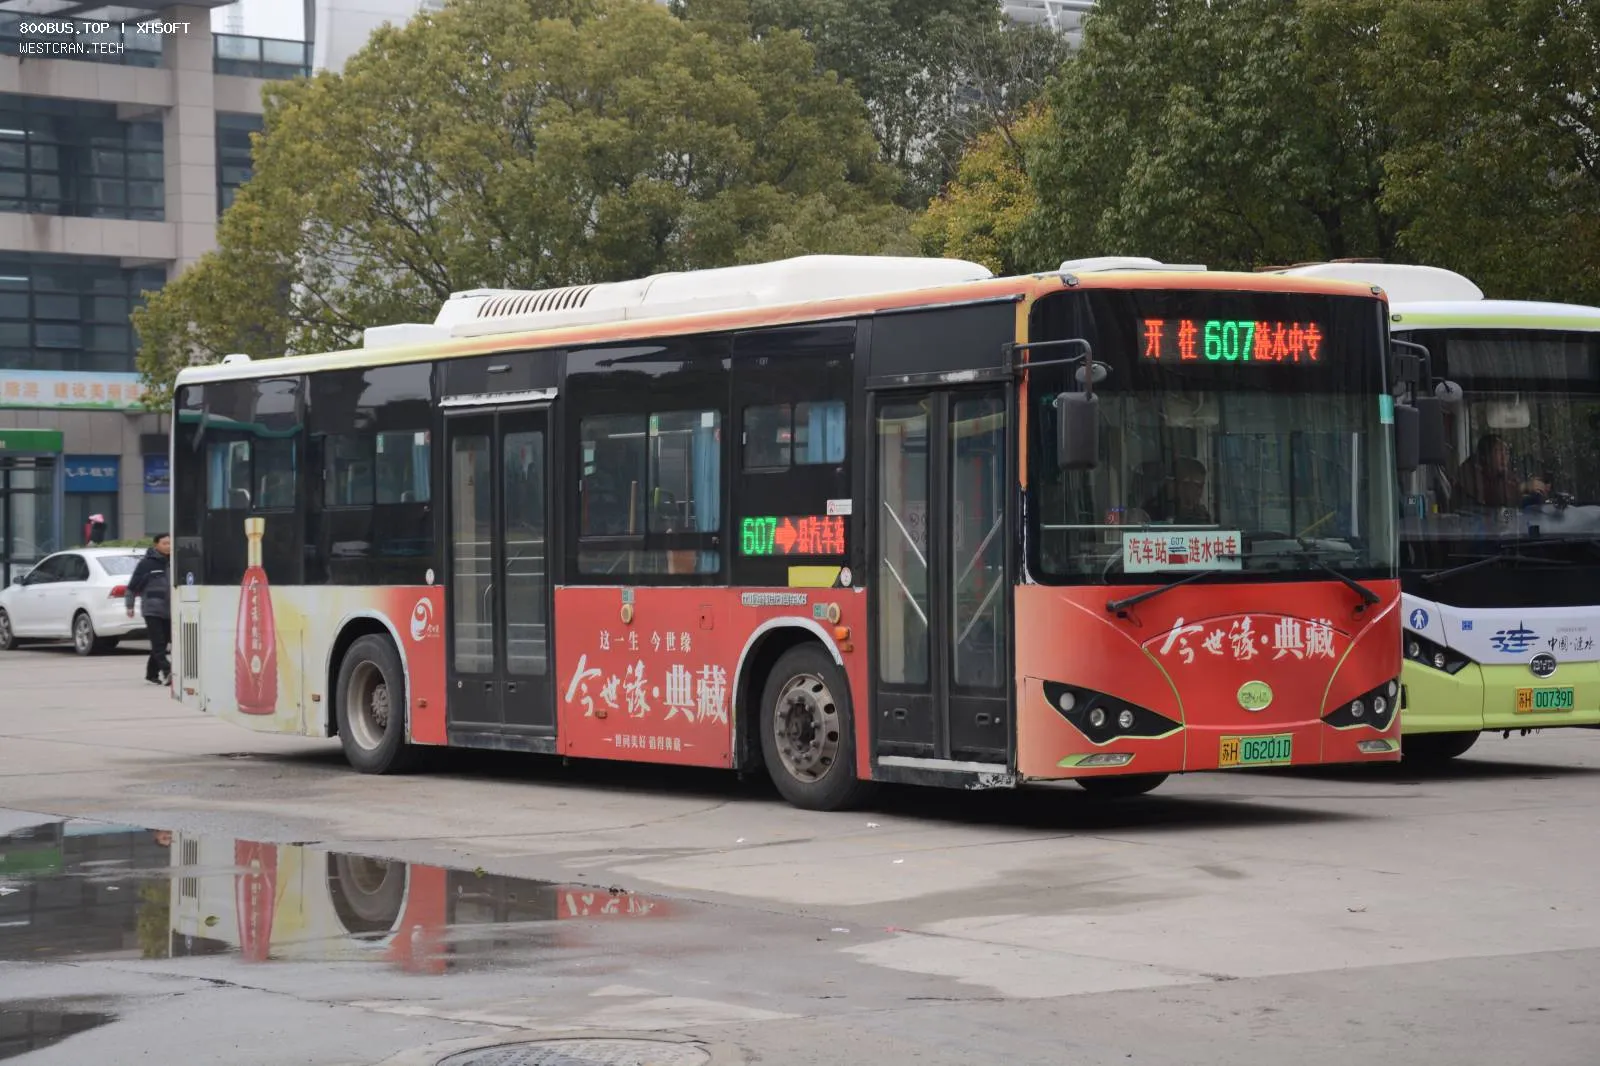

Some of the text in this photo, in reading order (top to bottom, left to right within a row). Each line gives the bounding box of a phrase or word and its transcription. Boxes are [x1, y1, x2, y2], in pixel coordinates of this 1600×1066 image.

[1204, 320, 1254, 361] 607
[743, 517, 777, 555] 607
[1128, 537, 1167, 565] 汽车站
[599, 630, 693, 653] 这一生 今世缘
[1243, 739, 1291, 760] 06201D
